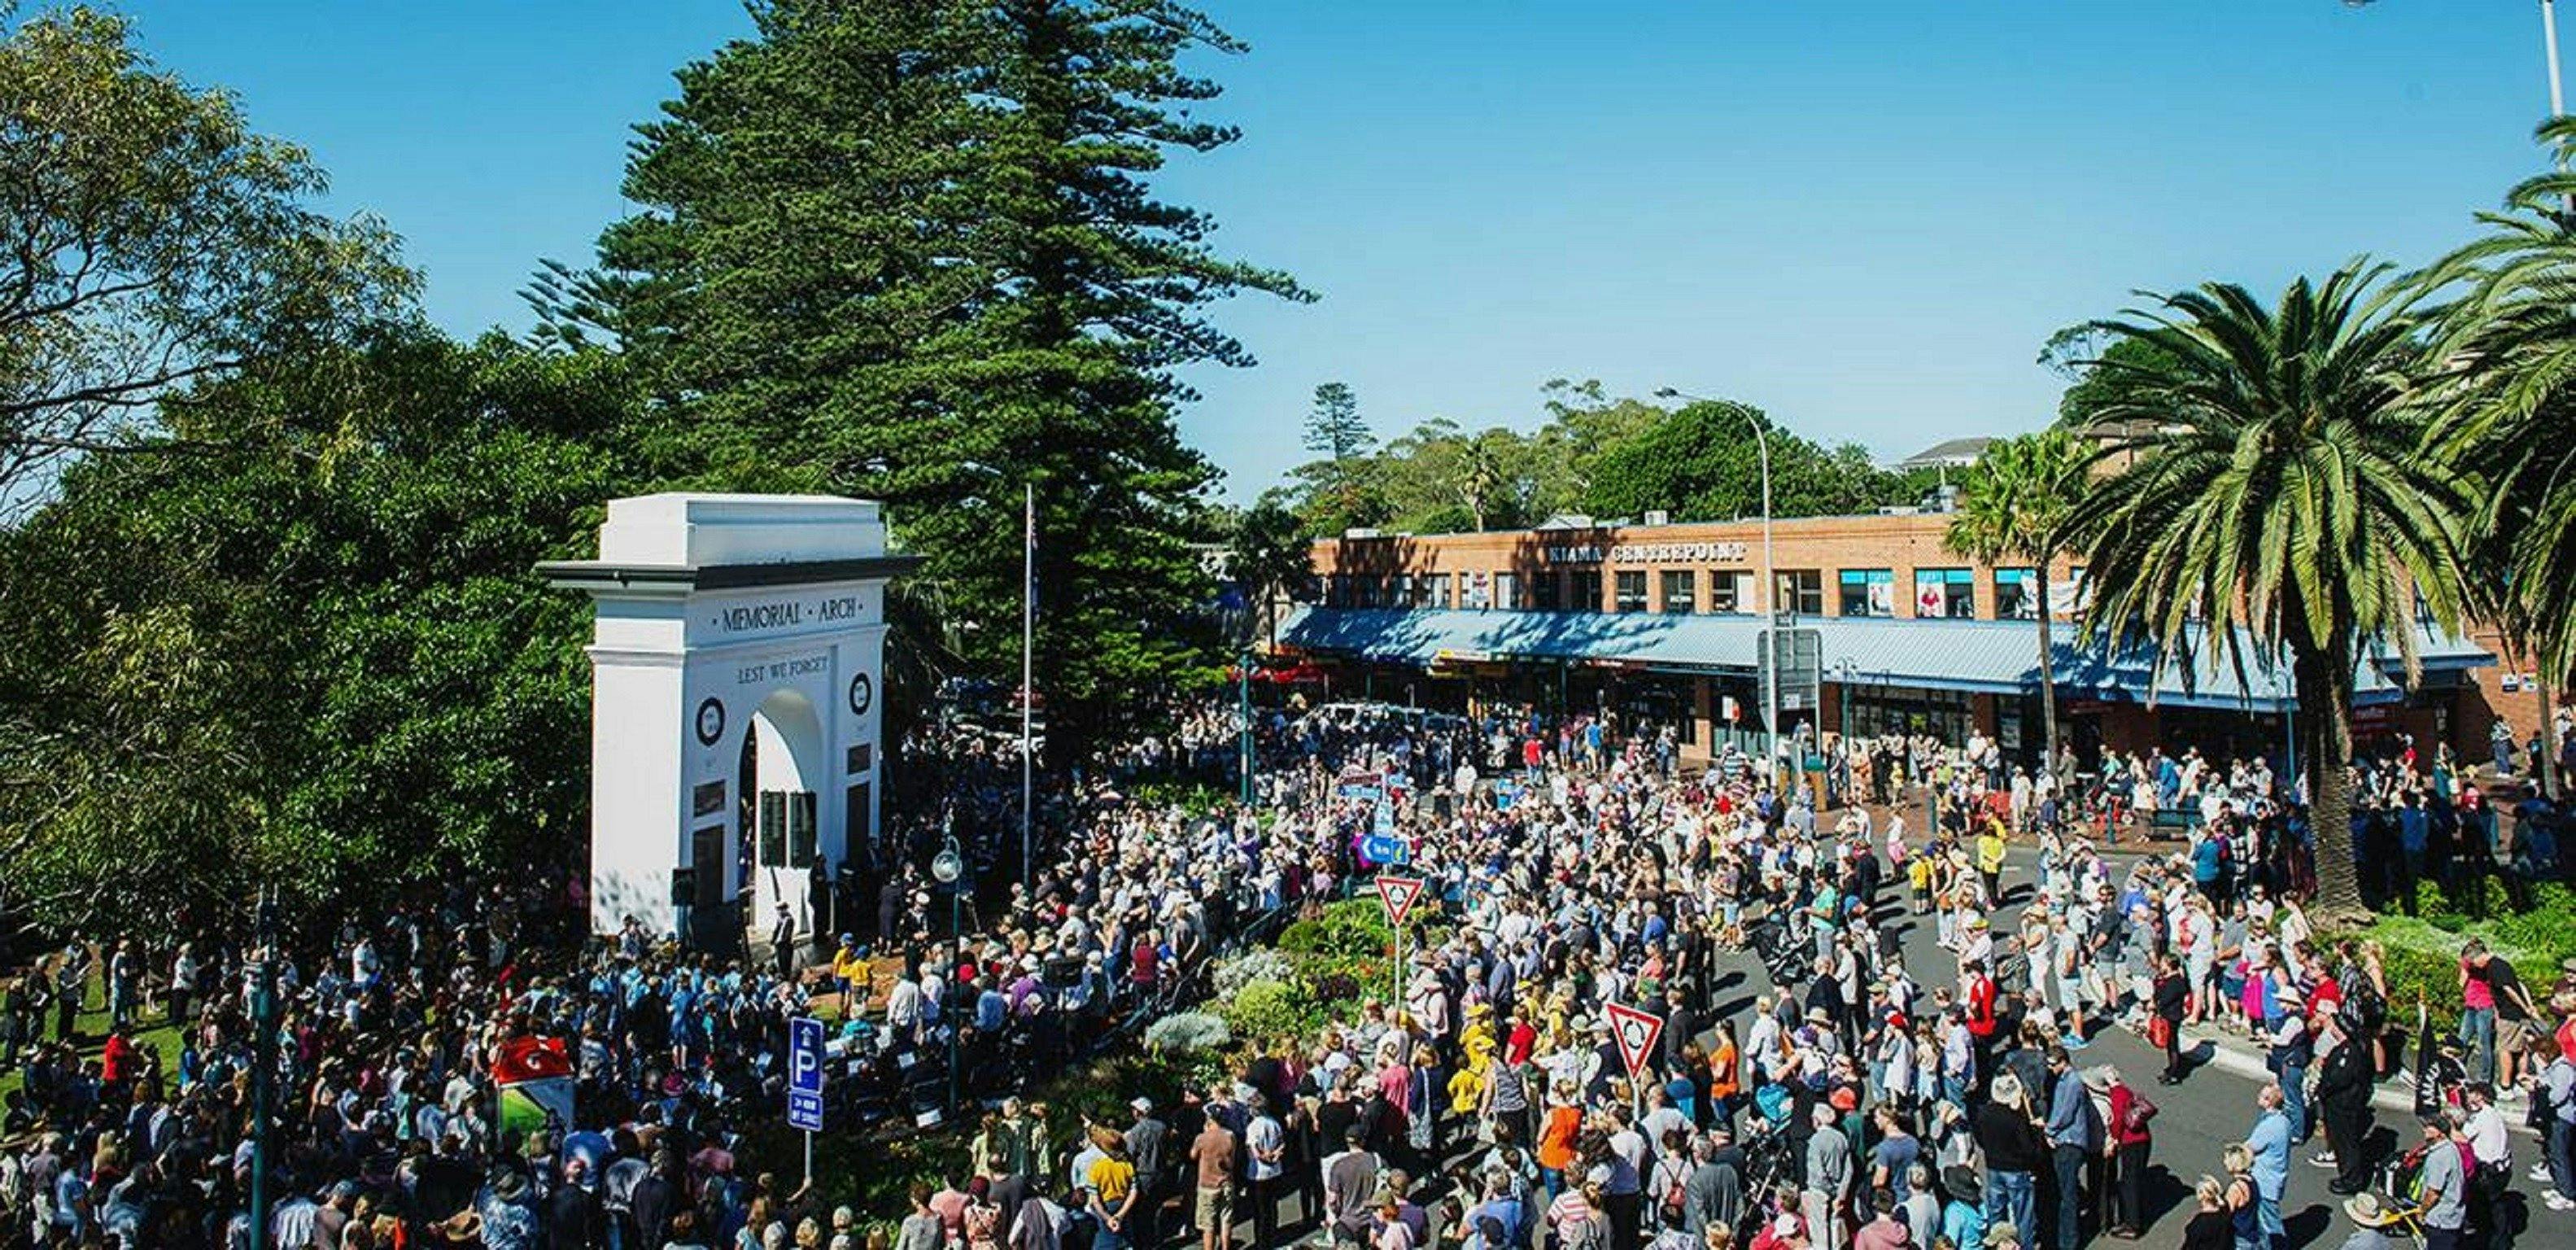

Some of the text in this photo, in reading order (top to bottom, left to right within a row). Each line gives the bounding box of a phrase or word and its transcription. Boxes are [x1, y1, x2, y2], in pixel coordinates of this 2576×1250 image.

[1548, 543, 1748, 564] KIAMA CENTREPOINT
[723, 598, 856, 632] MEMORIAL ARCH
[738, 656, 827, 684] LEST WE FORGET
[796, 1049, 816, 1083] P
